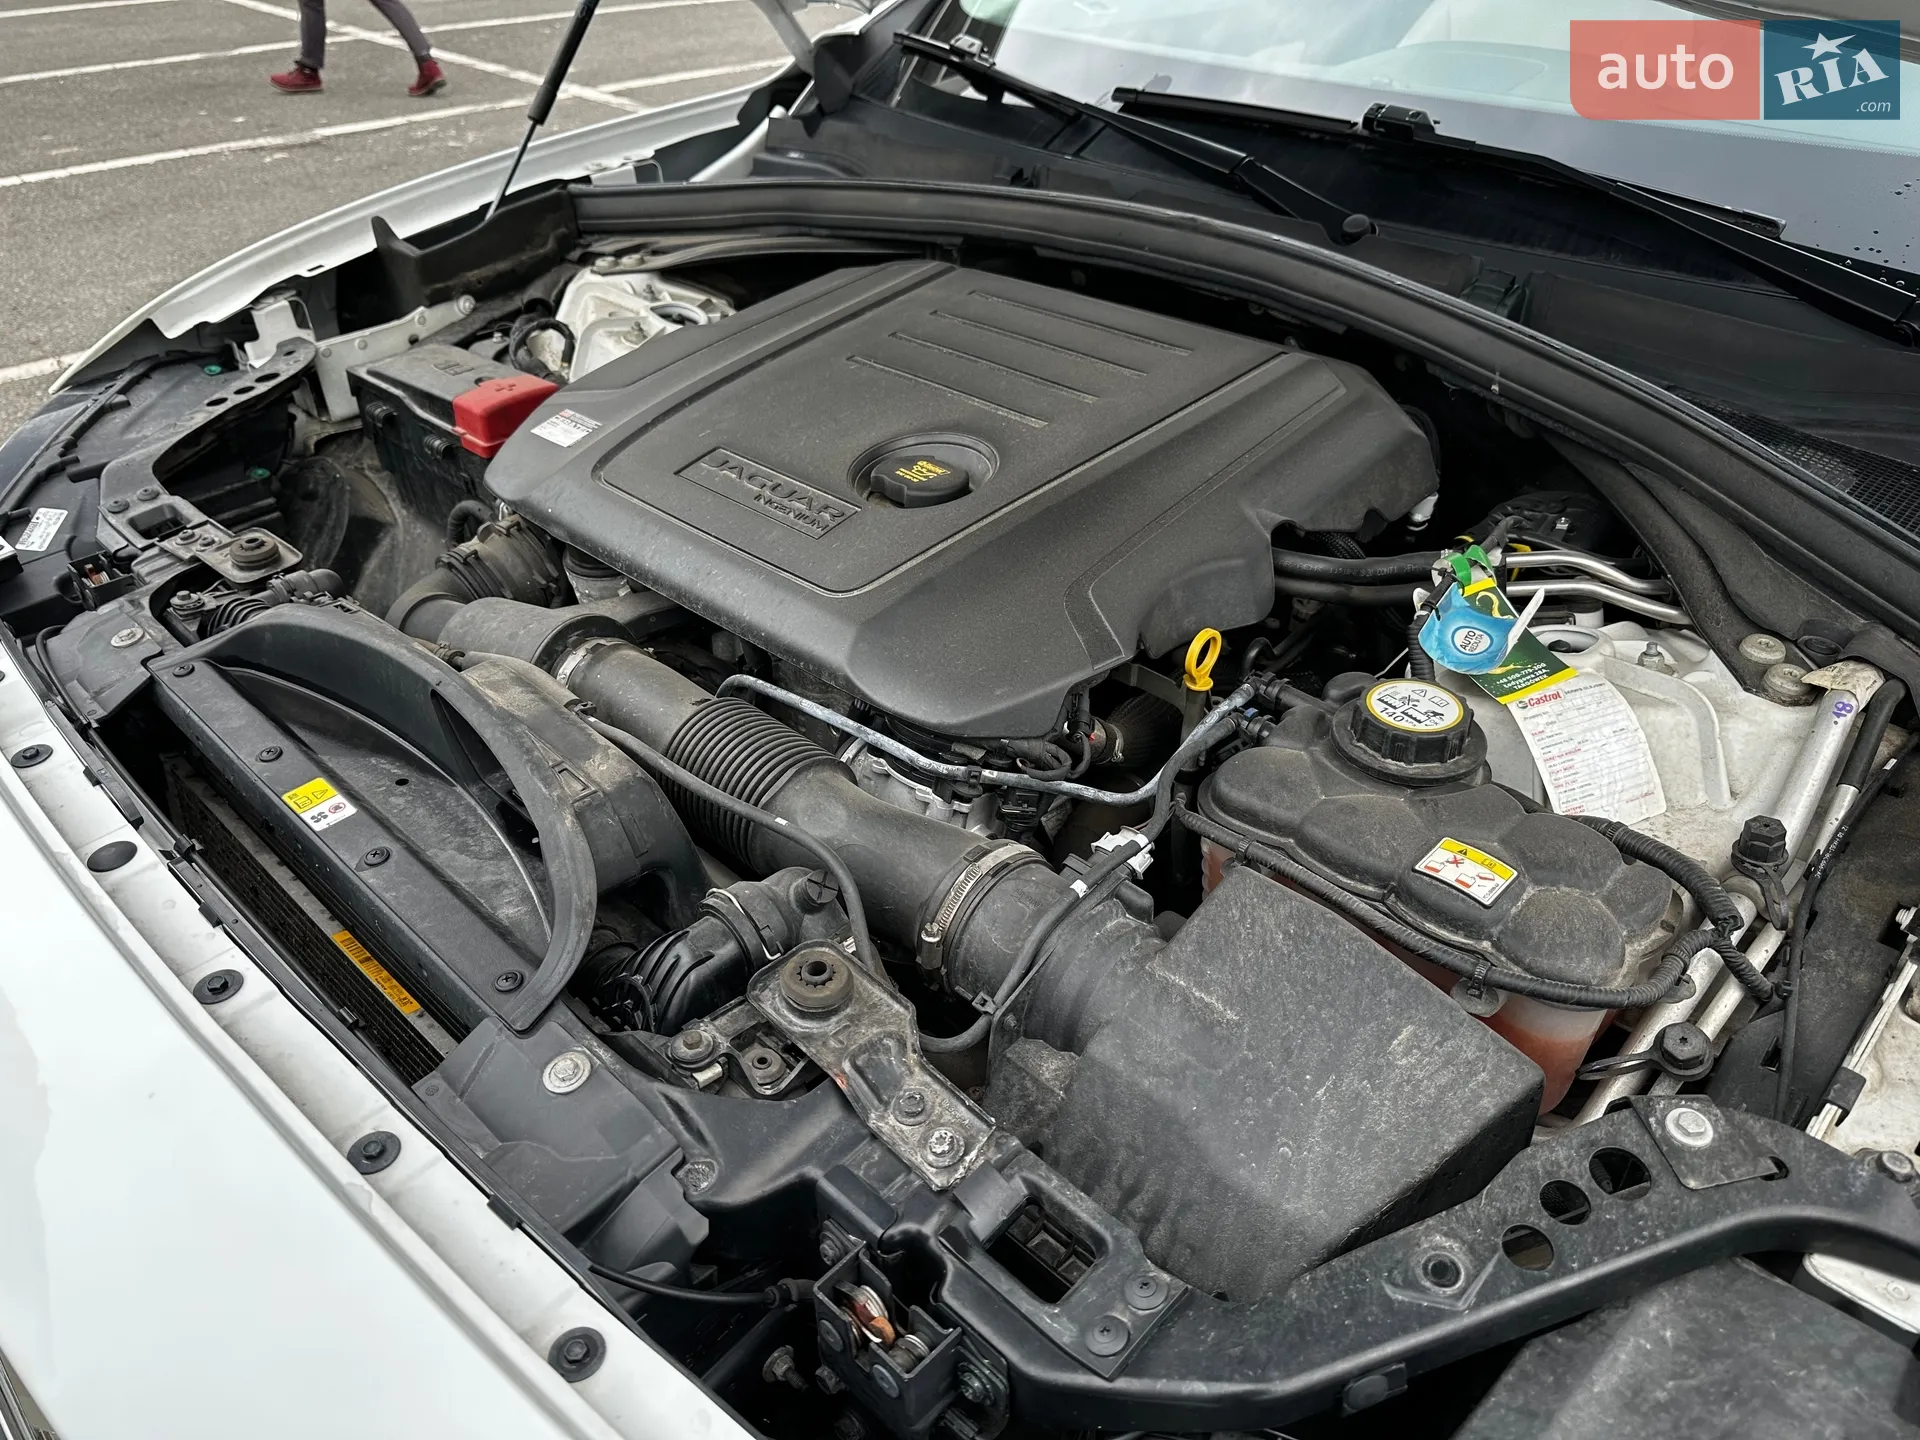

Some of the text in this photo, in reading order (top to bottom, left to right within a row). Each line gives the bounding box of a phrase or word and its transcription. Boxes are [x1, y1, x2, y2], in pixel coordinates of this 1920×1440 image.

[700, 455, 848, 522] JAGUAR
[753, 493, 829, 532] INGENIUM
[1459, 630, 1476, 651] AUTO
[1469, 633, 1485, 653] REDUTA
[1527, 690, 1563, 708] Castrol
[1379, 707, 1405, 723] 140
